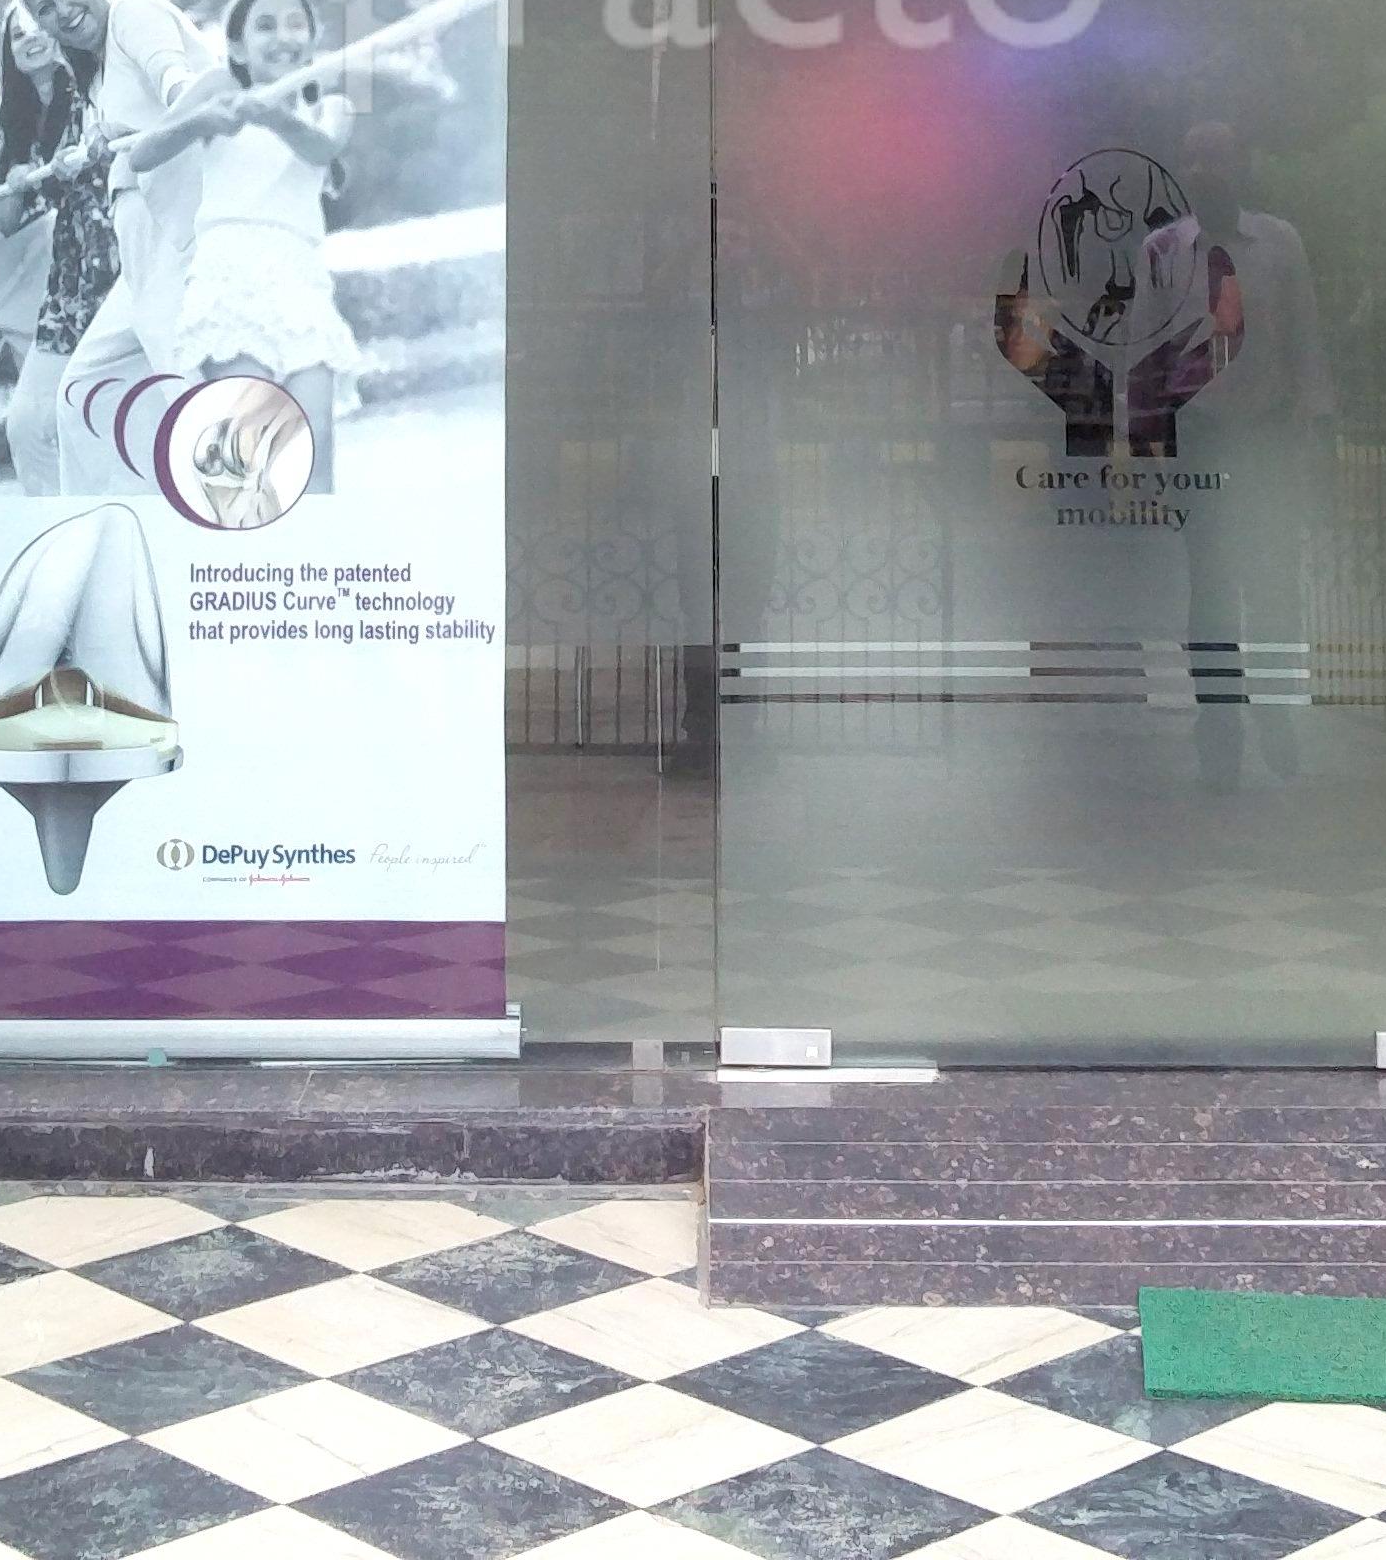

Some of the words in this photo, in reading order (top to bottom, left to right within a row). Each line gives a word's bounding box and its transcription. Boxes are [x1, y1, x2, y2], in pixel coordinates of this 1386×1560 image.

[1016, 465, 1089, 490] Care
[1100, 465, 1146, 491] for
[1154, 472, 1225, 495] your
[1057, 500, 1191, 532] mobility
[190, 563, 294, 586] Introducing
[300, 563, 328, 582] the
[334, 563, 412, 586] patented
[190, 592, 276, 611] GRADIUS
[355, 592, 455, 614] technology
[189, 620, 224, 639] that
[230, 621, 308, 643] provides
[314, 621, 353, 643] long
[359, 621, 419, 644] lasting
[425, 621, 495, 644] stability
[202, 845, 270, 869] DePuy
[273, 844, 356, 869] Synthes
